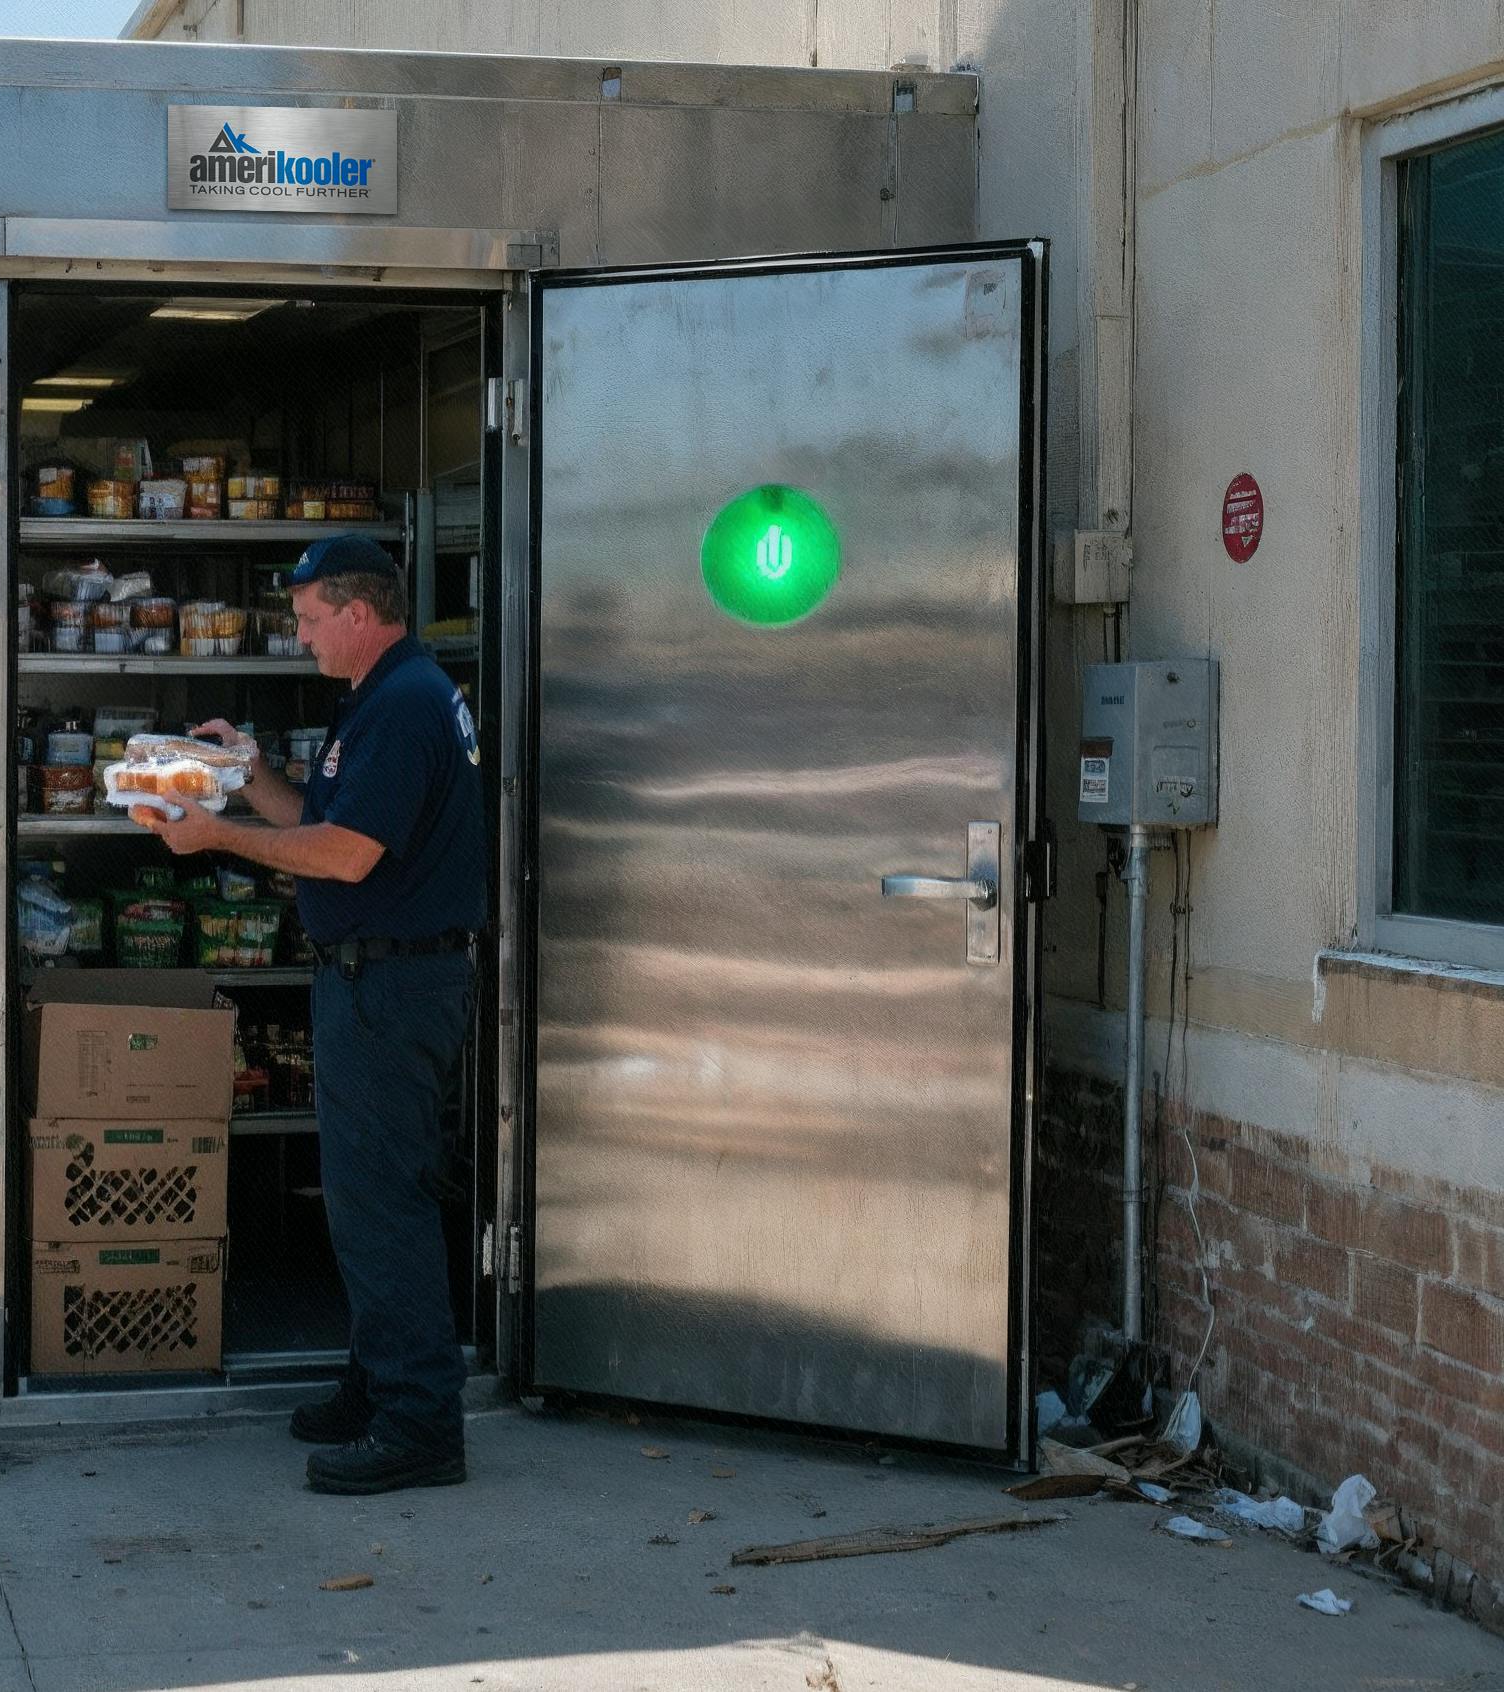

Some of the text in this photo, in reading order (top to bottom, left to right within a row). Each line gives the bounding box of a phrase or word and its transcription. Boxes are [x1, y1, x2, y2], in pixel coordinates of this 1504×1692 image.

[189, 150, 373, 187] amerikooler
[189, 184, 369, 199] TAKING COOL FURTHER
